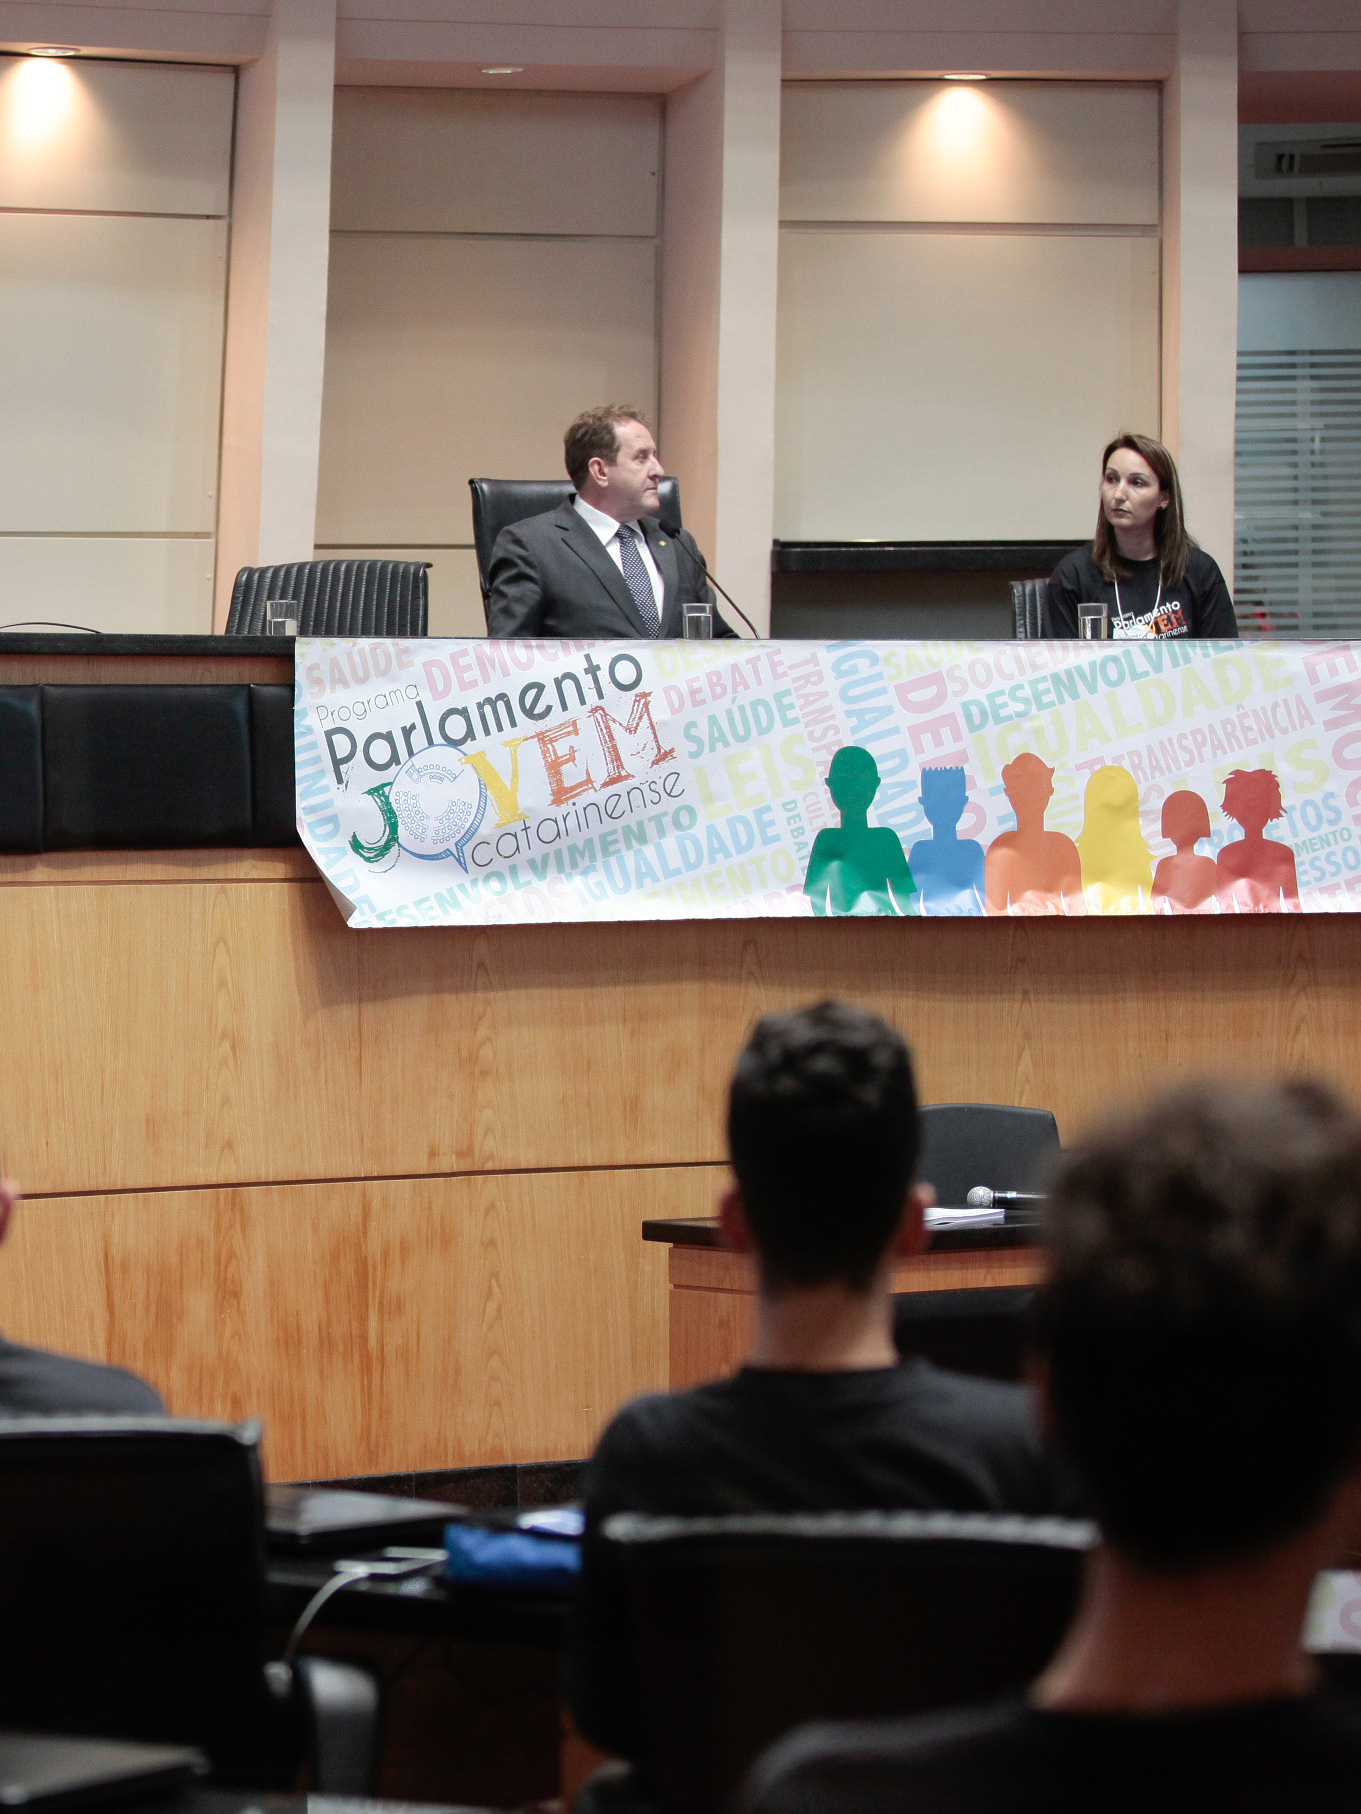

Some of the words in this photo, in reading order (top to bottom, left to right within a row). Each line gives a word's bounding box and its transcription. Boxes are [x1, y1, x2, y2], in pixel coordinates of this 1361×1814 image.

[316, 683, 420, 728] Programa
[325, 653, 643, 785] Parlamento
[662, 649, 789, 716] DEBATE
[683, 689, 801, 760] SAÚDE
[968, 641, 1295, 784] IGUALDADE
[693, 733, 817, 821] LEIS
[1110, 694, 1315, 786] TRANSPARÊNCIA
[471, 770, 686, 868] catarinense
